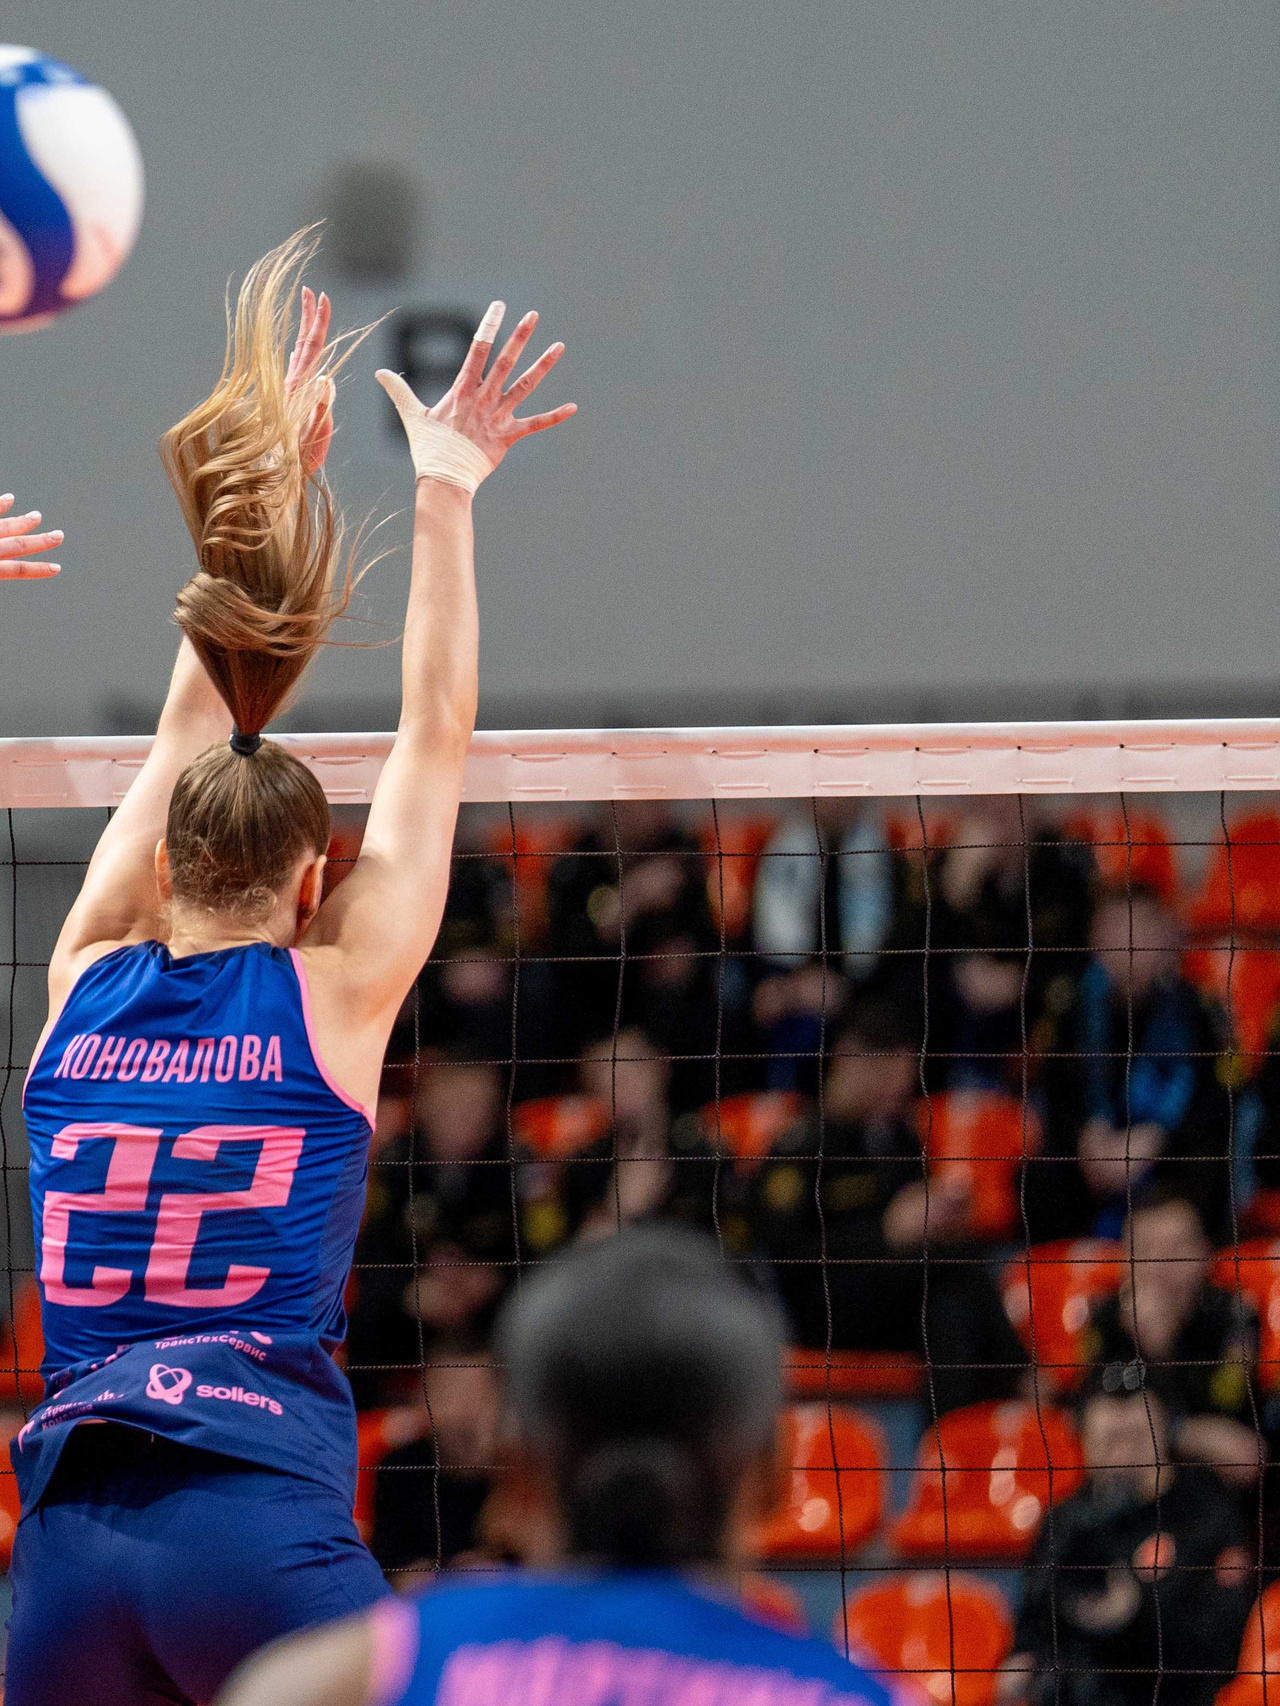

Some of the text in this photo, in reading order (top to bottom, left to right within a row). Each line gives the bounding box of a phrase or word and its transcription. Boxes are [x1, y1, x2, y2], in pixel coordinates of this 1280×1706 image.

[53, 1032, 283, 1084] КОНОВАЛОВА
[39, 1121, 308, 1308] 22
[153, 1333, 268, 1363] ТрансТехСервис
[195, 1383, 284, 1416] sollers
